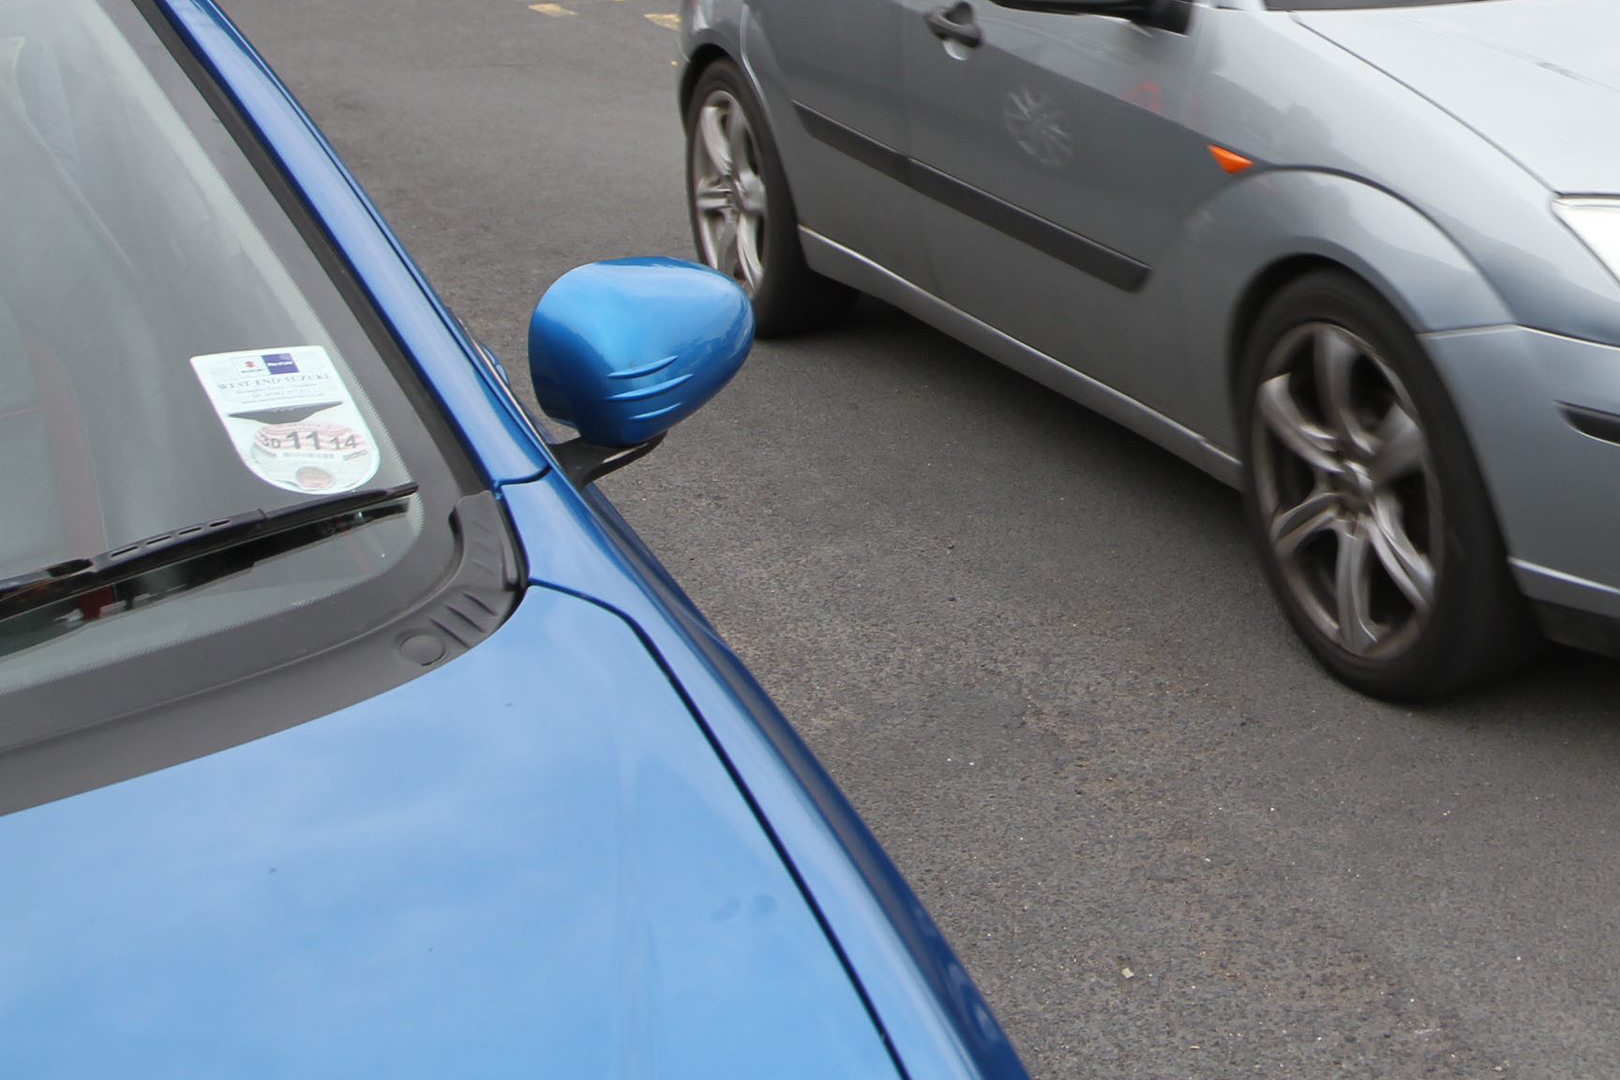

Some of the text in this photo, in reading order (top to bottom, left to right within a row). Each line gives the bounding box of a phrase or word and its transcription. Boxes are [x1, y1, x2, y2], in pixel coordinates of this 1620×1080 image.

[259, 430, 359, 451] 30 11 14
